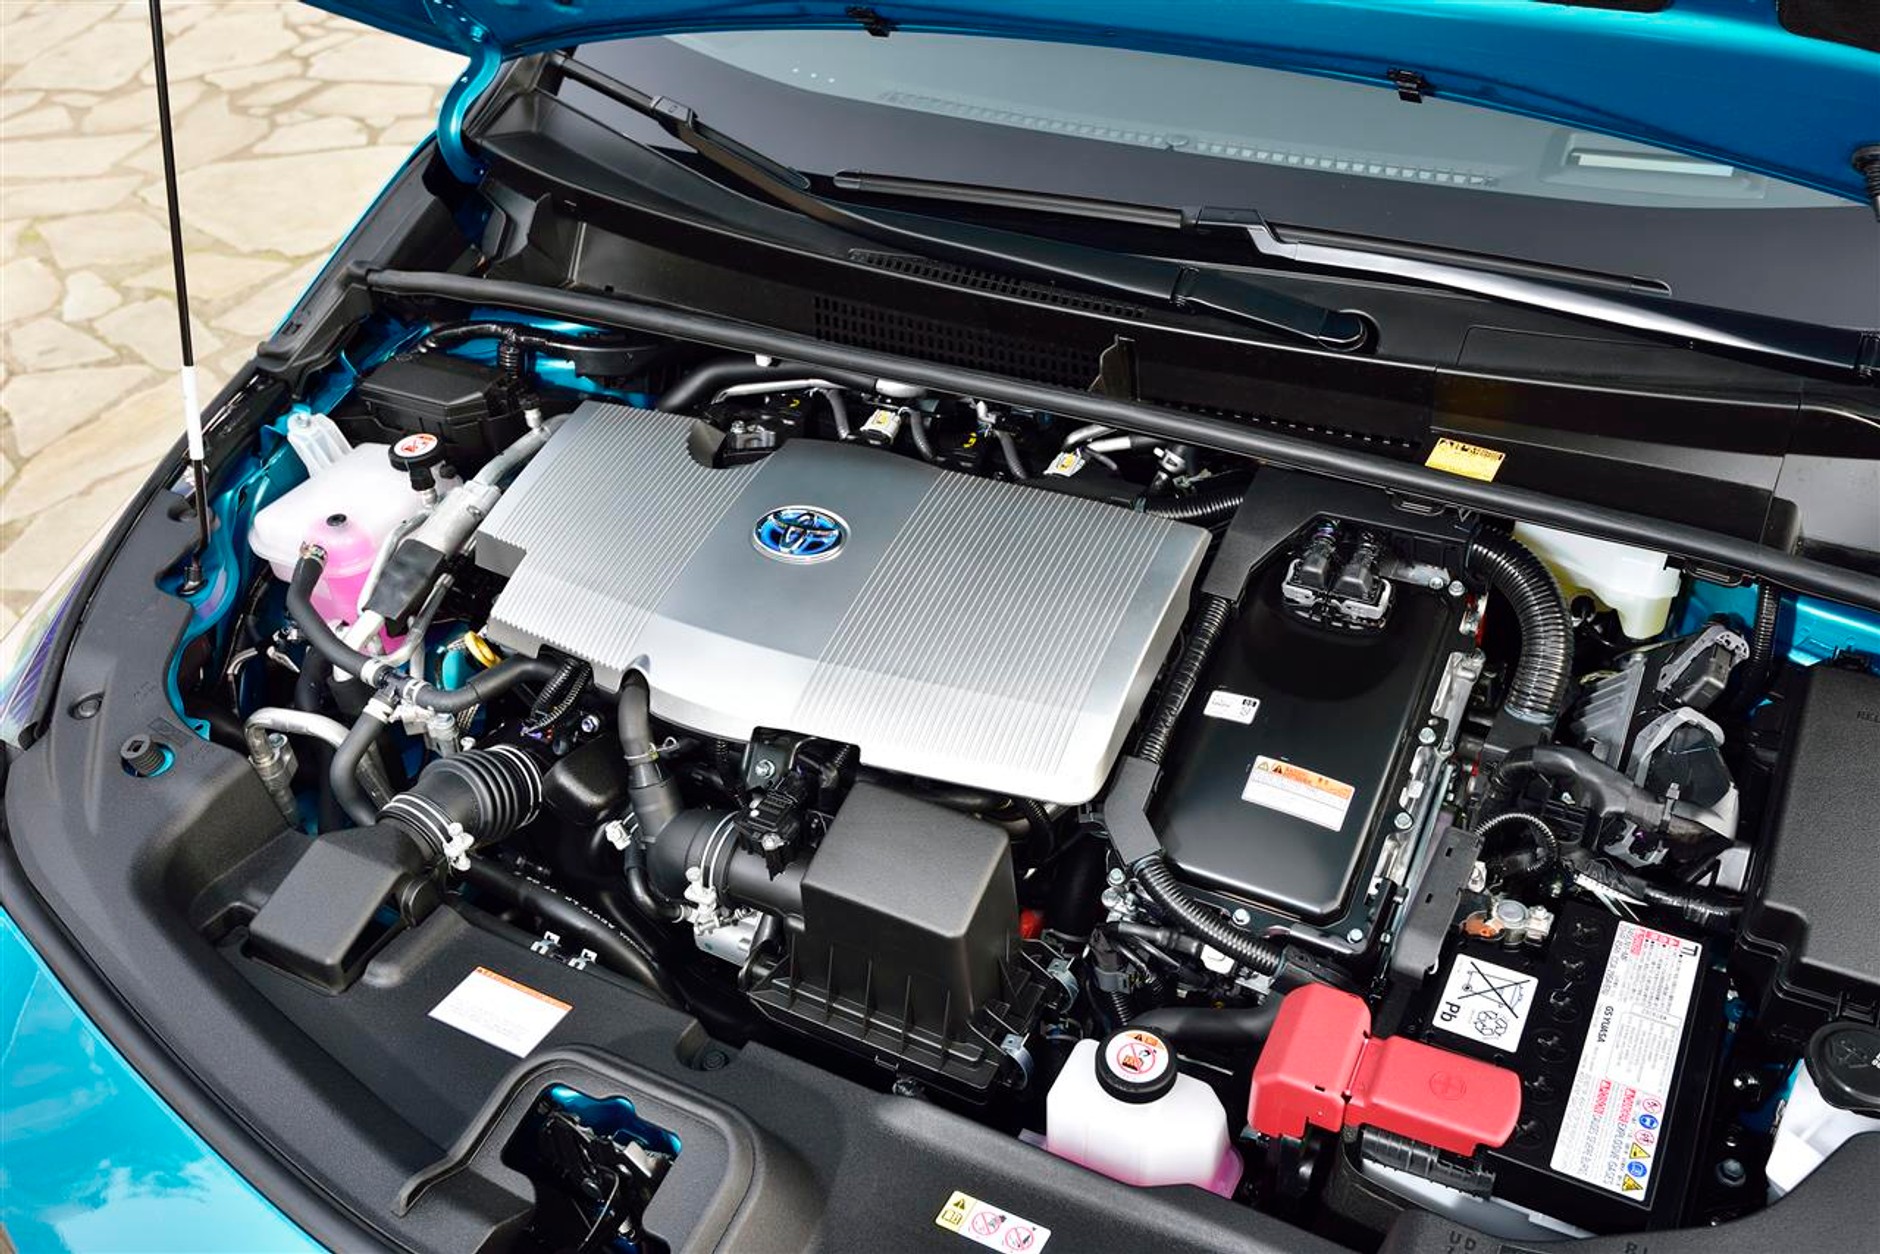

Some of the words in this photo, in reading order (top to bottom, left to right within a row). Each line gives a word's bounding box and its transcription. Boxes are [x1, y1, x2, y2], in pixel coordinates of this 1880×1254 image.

[1440, 1001, 1461, 1022] Pb
[1603, 1005, 1614, 1016] GS
[1596, 1016, 1611, 1044] YUASA
[1609, 1121, 1627, 1160] EXPLOSIVE
[1602, 1159, 1618, 1186] GASES
